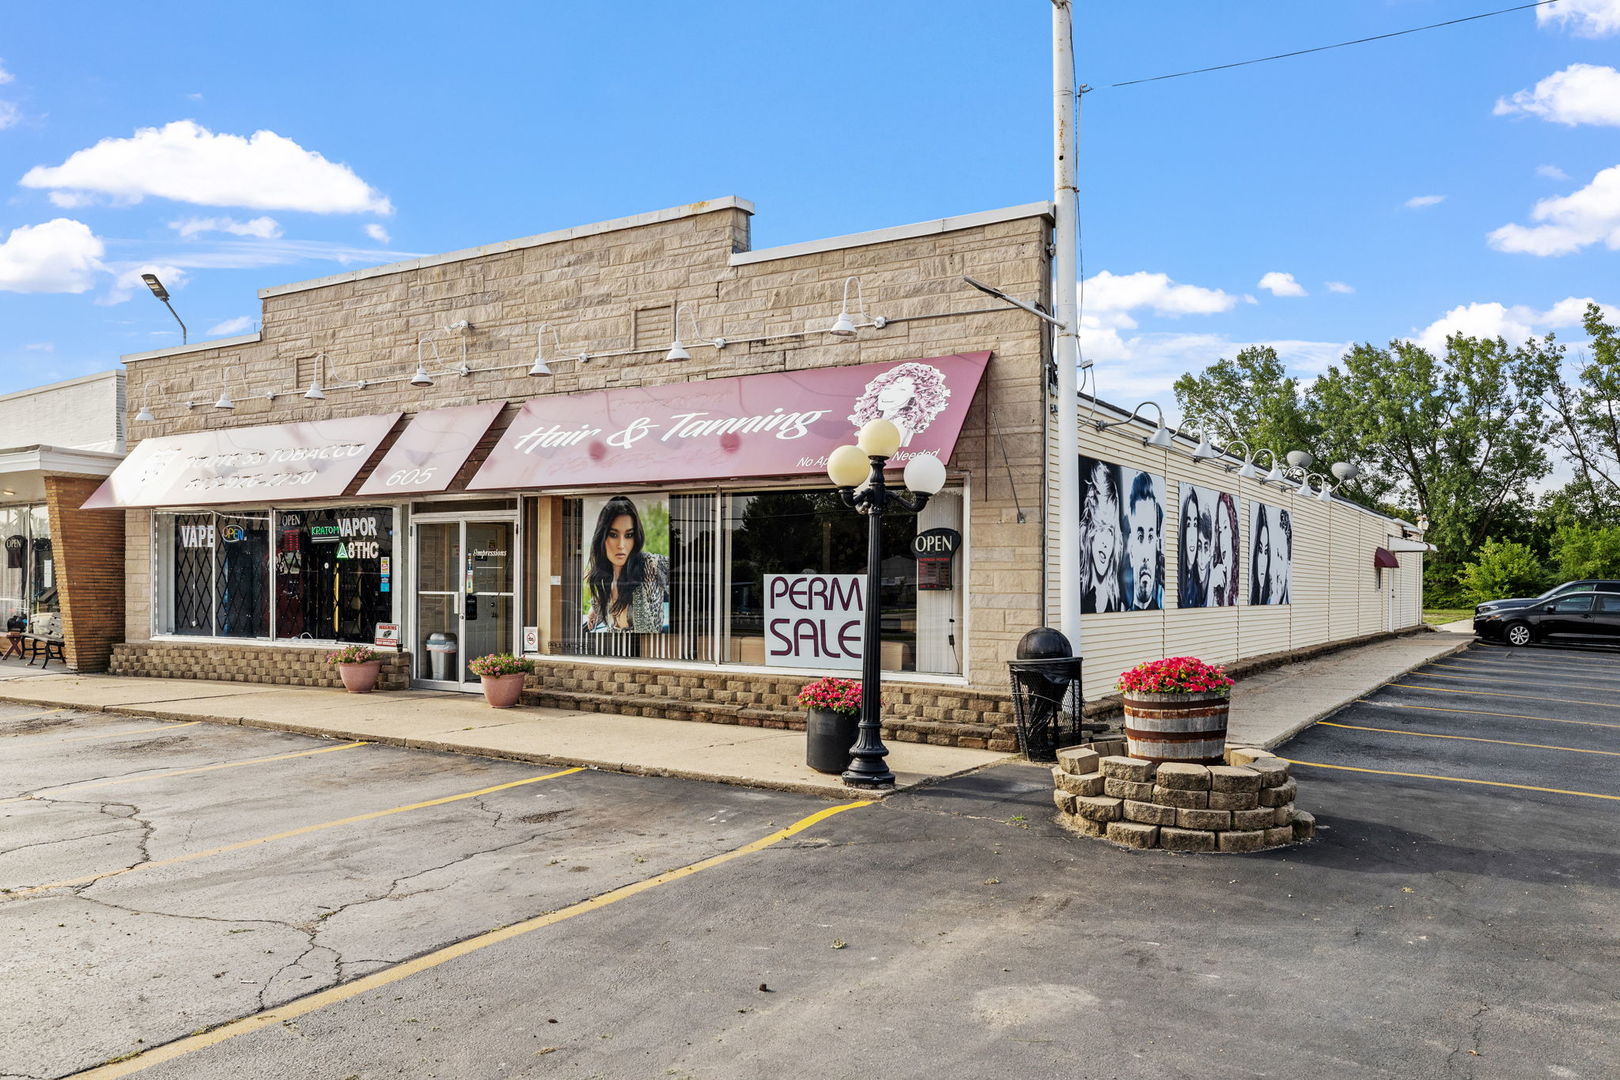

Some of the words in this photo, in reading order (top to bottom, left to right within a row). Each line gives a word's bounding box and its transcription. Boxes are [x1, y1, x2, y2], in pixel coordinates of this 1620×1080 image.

[513, 424, 602, 455] Hair
[606, 416, 660, 450] &
[660, 408, 832, 442] Tanning
[268, 444, 366, 463] TOBACCO
[796, 457, 813, 468] No
[386, 467, 437, 487] 605
[282, 514, 300, 526] OPEN
[337, 516, 378, 538] VAPOR
[181, 525, 214, 547] VAPE
[223, 527, 244, 541] OPEN
[915, 535, 952, 552] OPEN
[473, 549, 507, 559] Impressions
[770, 576, 863, 611] PERM
[769, 618, 862, 659] SALE
